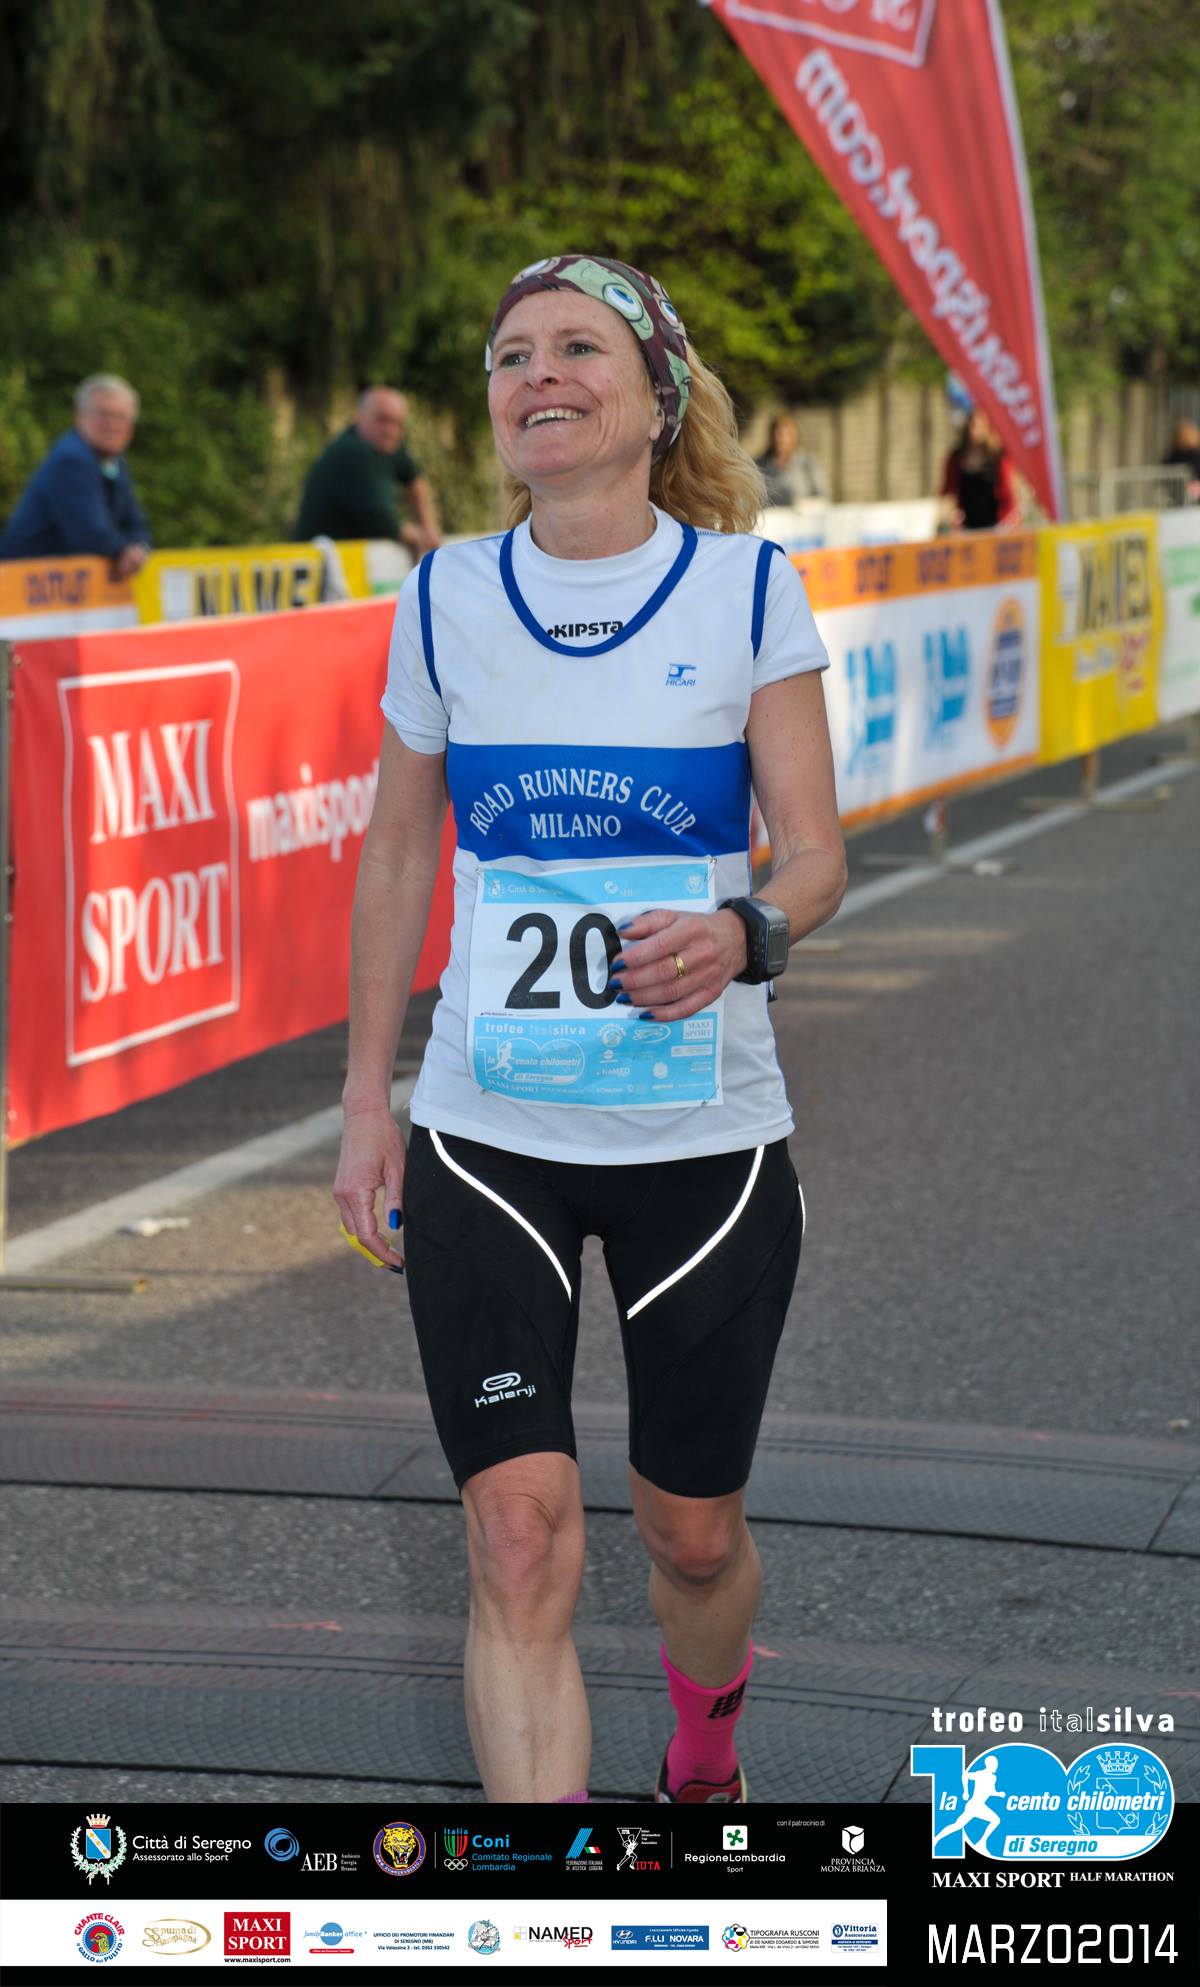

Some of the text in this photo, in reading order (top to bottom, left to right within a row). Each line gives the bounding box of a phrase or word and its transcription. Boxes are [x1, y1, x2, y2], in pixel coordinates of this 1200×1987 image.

[664, 679, 697, 687] HICARI
[89, 719, 216, 845] MAXI
[469, 768, 697, 837] ROAD RUNNERS CLUB
[530, 813, 622, 840] MILANO
[81, 862, 228, 1004] SPORT
[485, 1022, 524, 1034] trofeo
